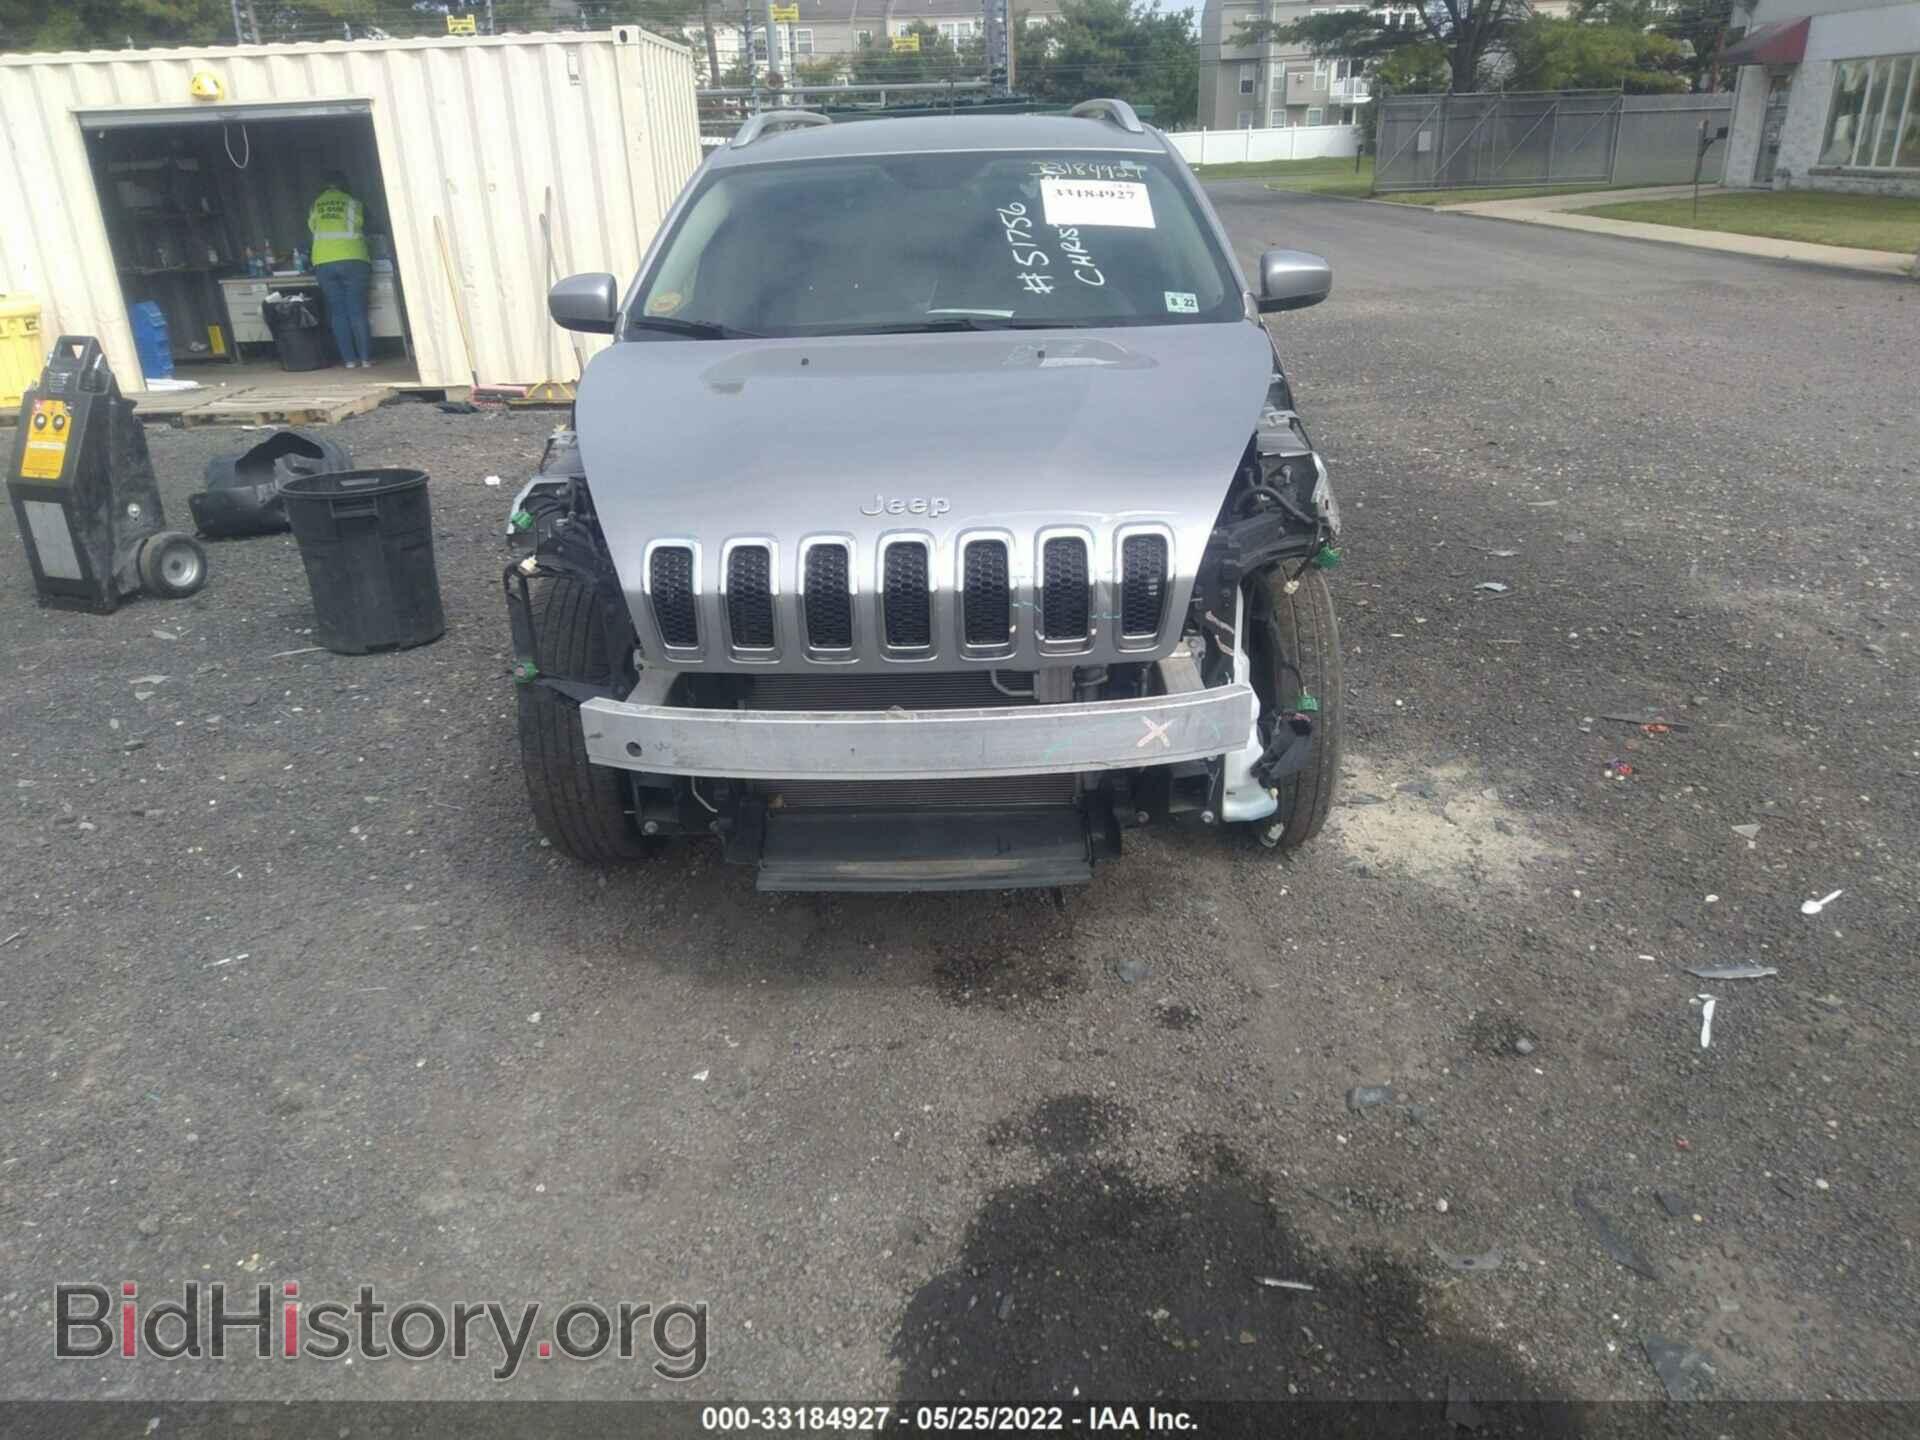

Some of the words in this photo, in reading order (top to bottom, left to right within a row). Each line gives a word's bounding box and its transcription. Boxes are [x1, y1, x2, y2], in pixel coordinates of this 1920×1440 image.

[996, 201, 1055, 294] #51756
[1055, 223, 1105, 286] CHRIS
[1184, 298, 1196, 307] 22
[860, 493, 951, 518] Jeep
